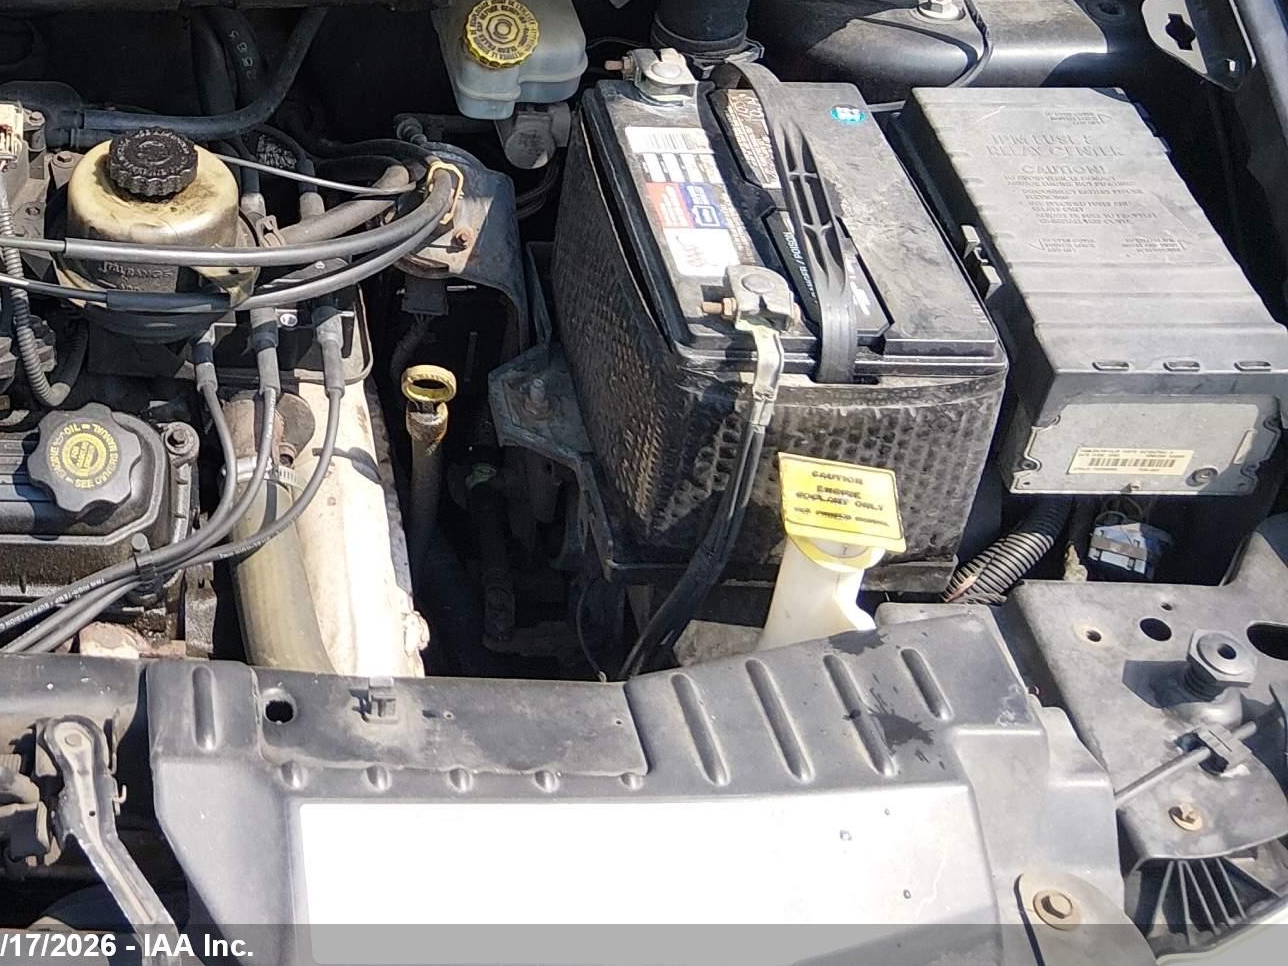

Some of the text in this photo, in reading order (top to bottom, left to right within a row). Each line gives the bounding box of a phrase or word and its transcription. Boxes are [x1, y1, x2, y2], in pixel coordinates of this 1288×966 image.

[786, 232, 803, 260] POISON
[63, 423, 81, 435] OIL
[74, 478, 95, 488] SEE
[91, 423, 118, 453] MANUAL
[811, 470, 864, 486] CAUTION
[795, 491, 884, 511] COOLANT ONLY
[816, 485, 862, 500] ENGINE
